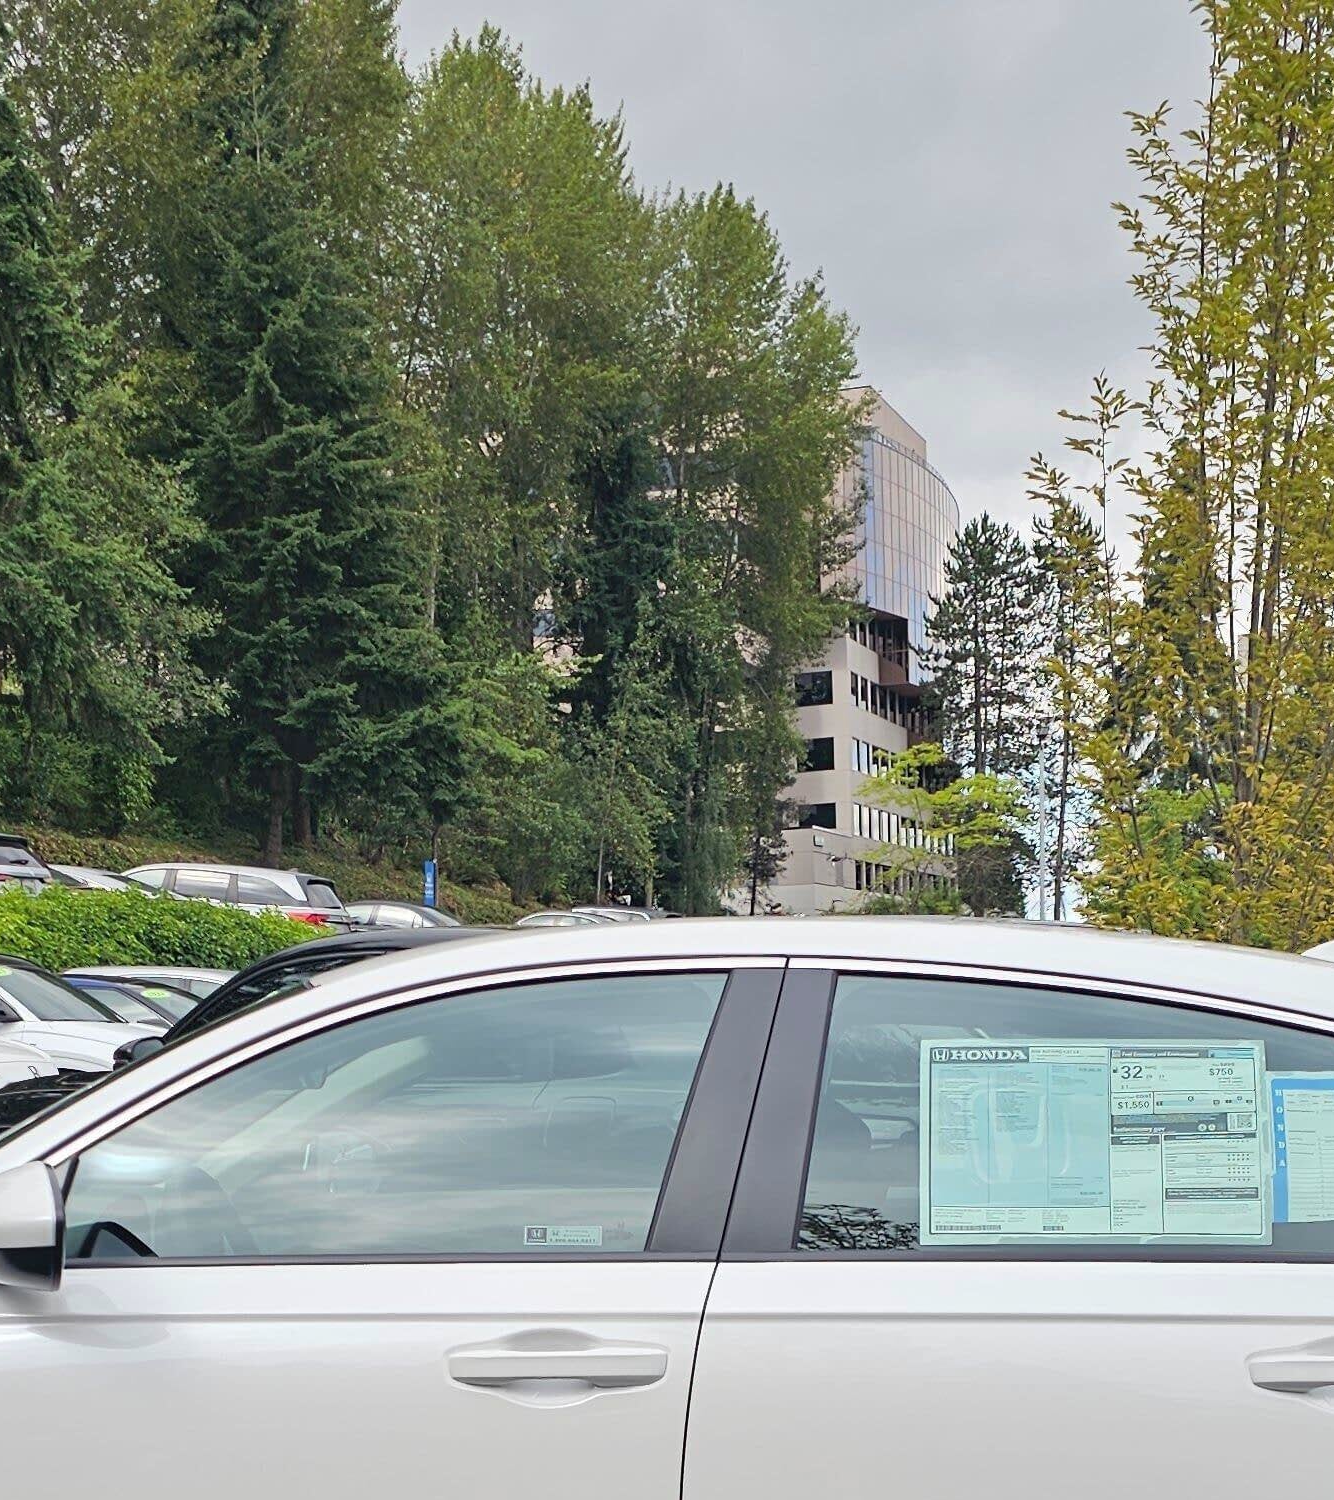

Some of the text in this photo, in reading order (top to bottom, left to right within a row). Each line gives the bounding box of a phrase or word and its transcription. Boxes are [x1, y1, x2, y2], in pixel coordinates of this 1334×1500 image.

[950, 1049, 1028, 1061] HONDA
[1121, 1065, 1143, 1079] 32
[1209, 1067, 1234, 1076] $750
[1274, 1089, 1286, 1167] HONDA
